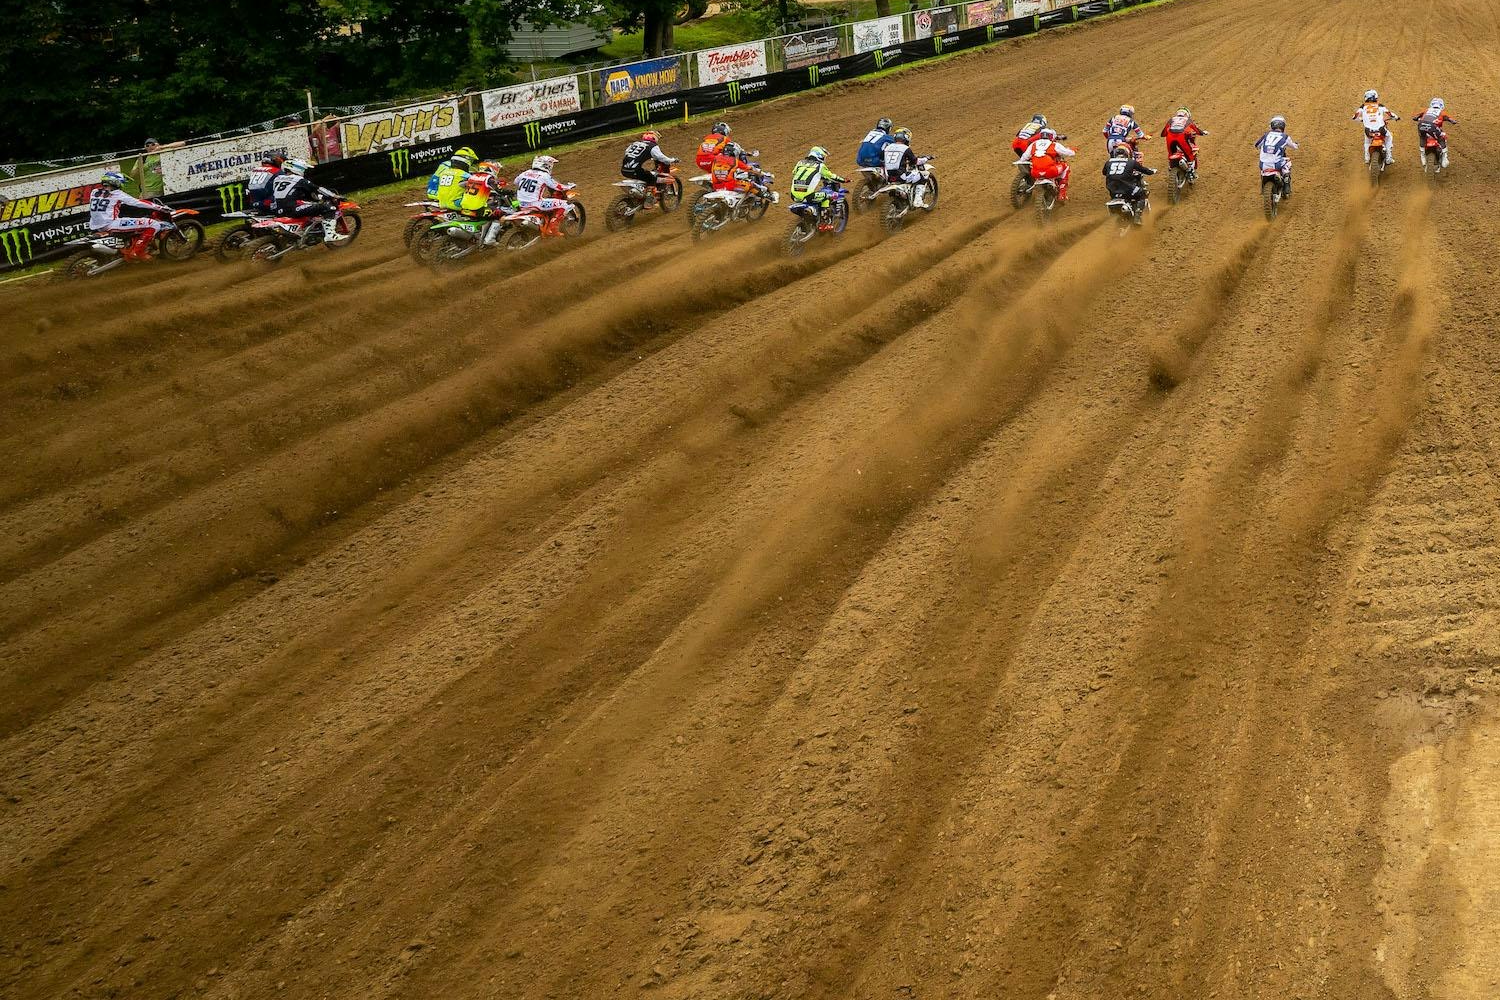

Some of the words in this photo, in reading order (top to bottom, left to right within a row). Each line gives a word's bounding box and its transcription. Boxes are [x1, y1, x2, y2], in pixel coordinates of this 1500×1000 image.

[708, 49, 757, 68] Trimble's
[609, 77, 630, 93] NAPA
[740, 80, 767, 91] MONSTER
[500, 108, 536, 120] HONDA
[549, 97, 577, 109] YAMAHA
[649, 98, 678, 110] MONSTER
[344, 105, 454, 153] VAITH'S
[541, 119, 577, 132] MONSTER
[411, 145, 453, 160] MONSTER
[187, 153, 251, 176] AMERICAN
[1109, 162, 1126, 175] 55
[519, 177, 537, 193] 746
[33, 222, 90, 241] MONSTE
